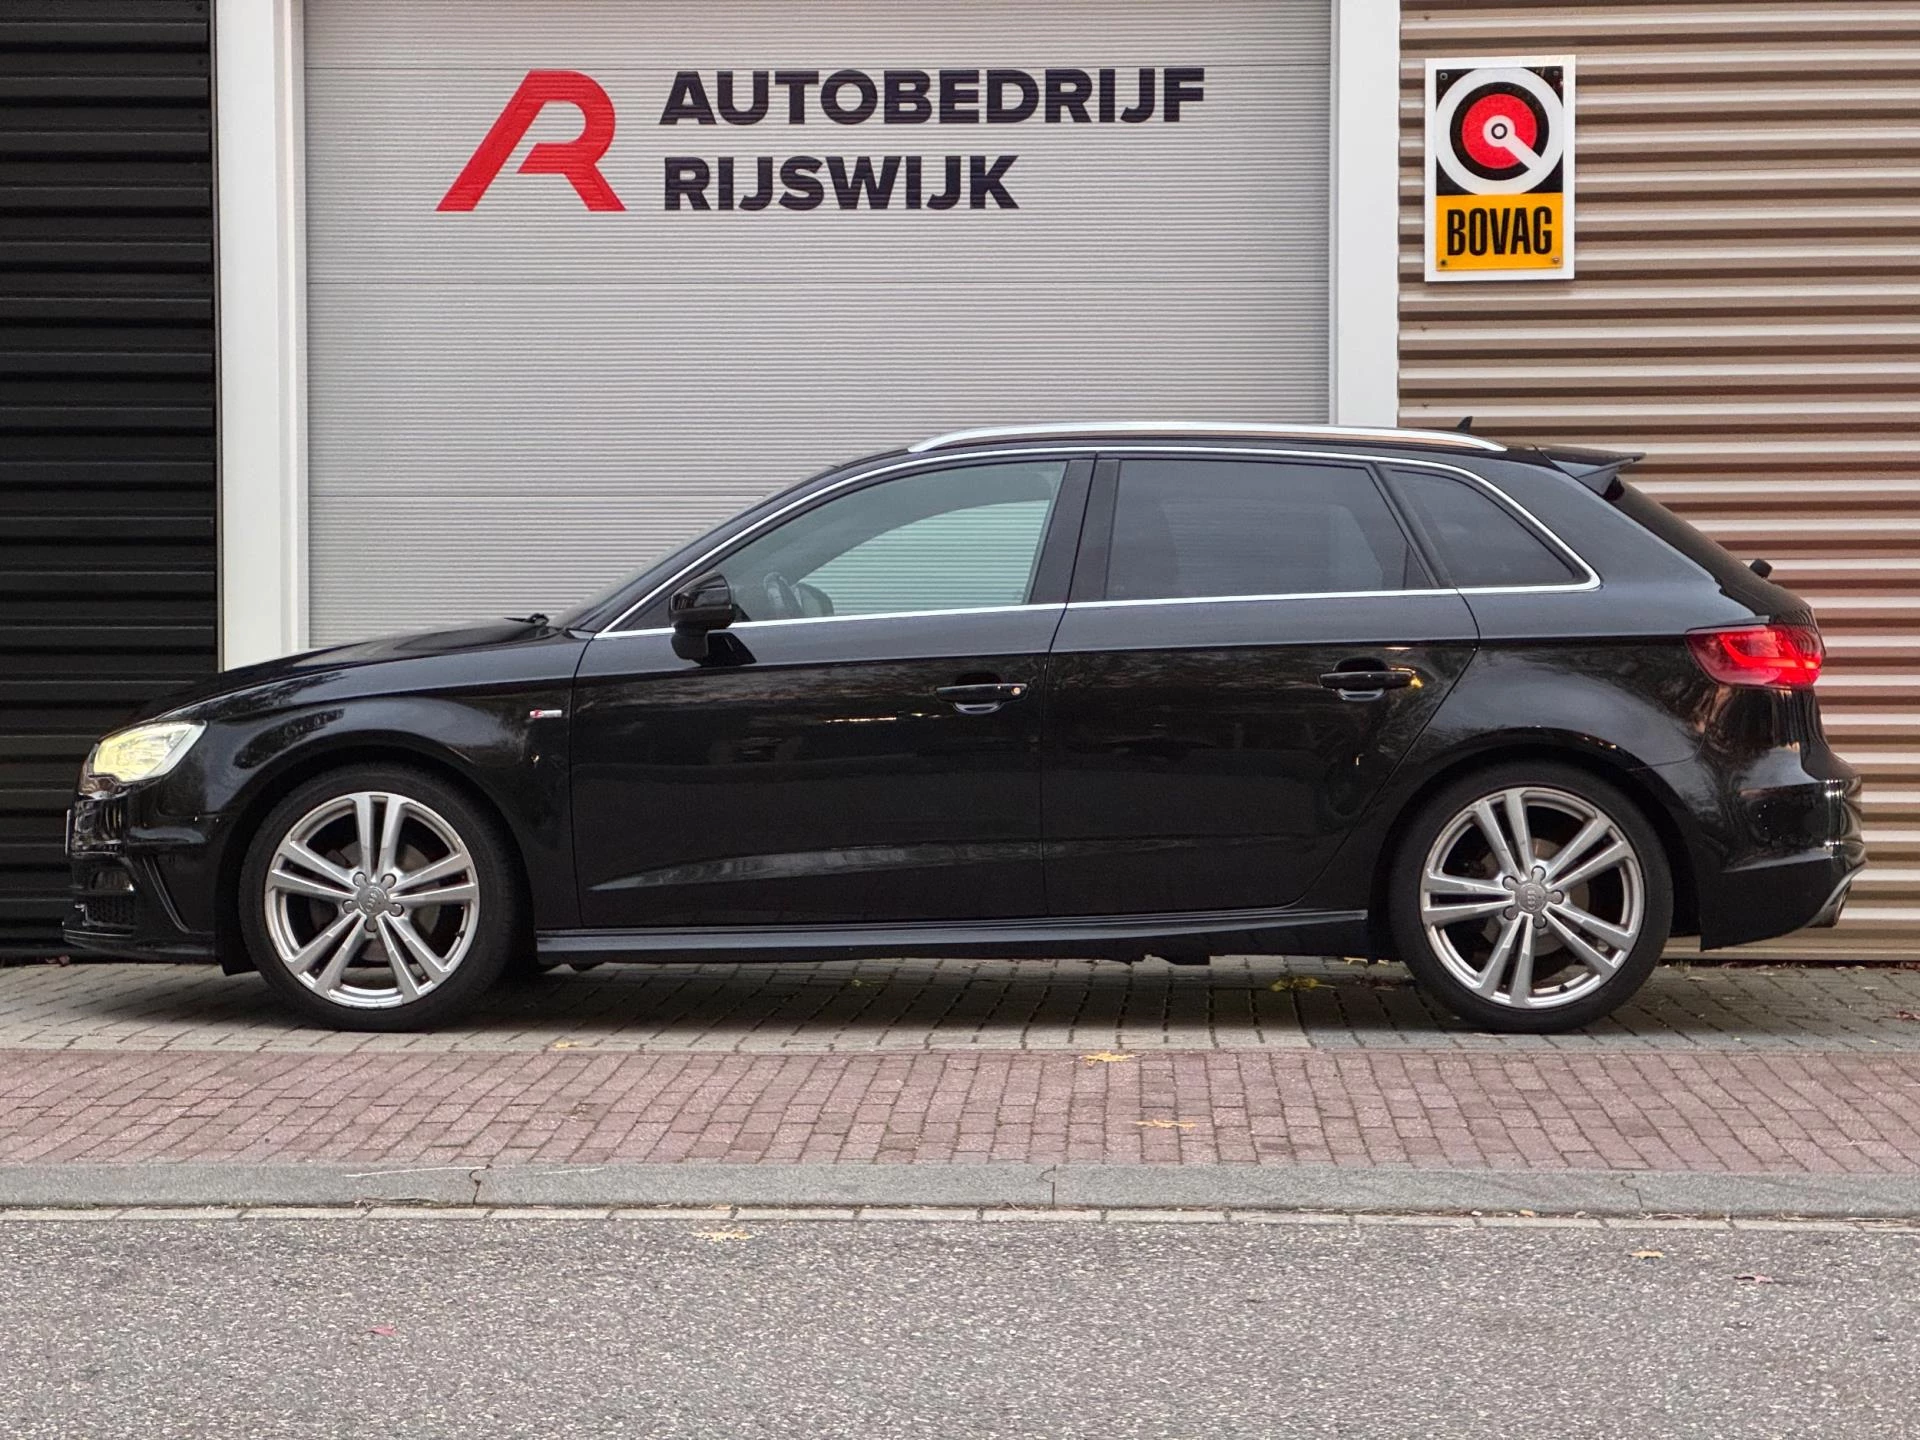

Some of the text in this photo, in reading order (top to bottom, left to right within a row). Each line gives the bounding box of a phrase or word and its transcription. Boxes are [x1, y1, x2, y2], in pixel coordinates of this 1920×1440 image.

[659, 67, 1205, 126] AUTOBEDRIJF
[664, 155, 1019, 212] RIJSWIJK
[1447, 206, 1553, 256] BOVAG
